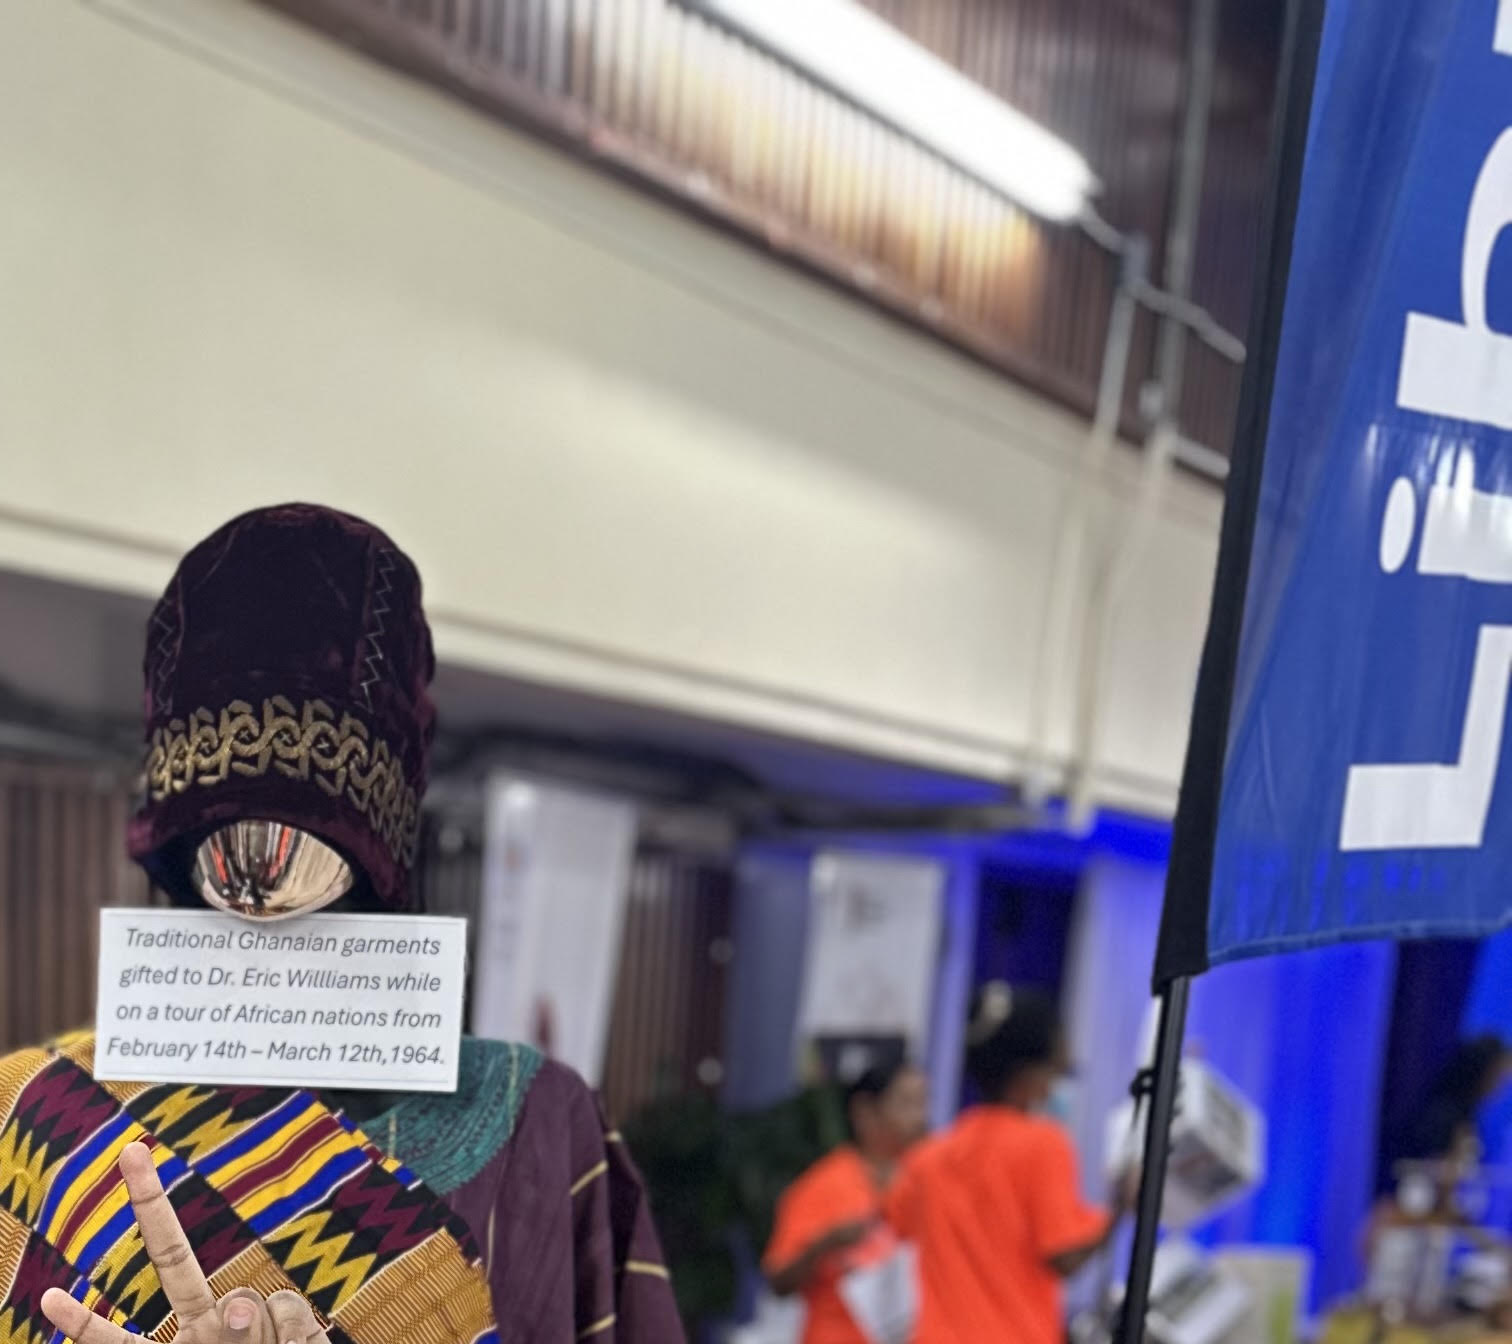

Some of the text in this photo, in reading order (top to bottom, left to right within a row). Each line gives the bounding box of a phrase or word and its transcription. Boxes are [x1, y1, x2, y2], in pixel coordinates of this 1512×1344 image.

[1340, 0, 1512, 851] Lib
[126, 927, 441, 957] Traditional Ghanaian garments
[119, 966, 178, 987] gifted
[183, 969, 202, 985] to
[208, 967, 234, 986] Dr.
[242, 968, 280, 987] Eric
[387, 973, 440, 991] while
[116, 1004, 441, 1028] on a tour of African nations from
[107, 1037, 198, 1062] February
[205, 1041, 246, 1058] 14th
[268, 1042, 331, 1061] March
